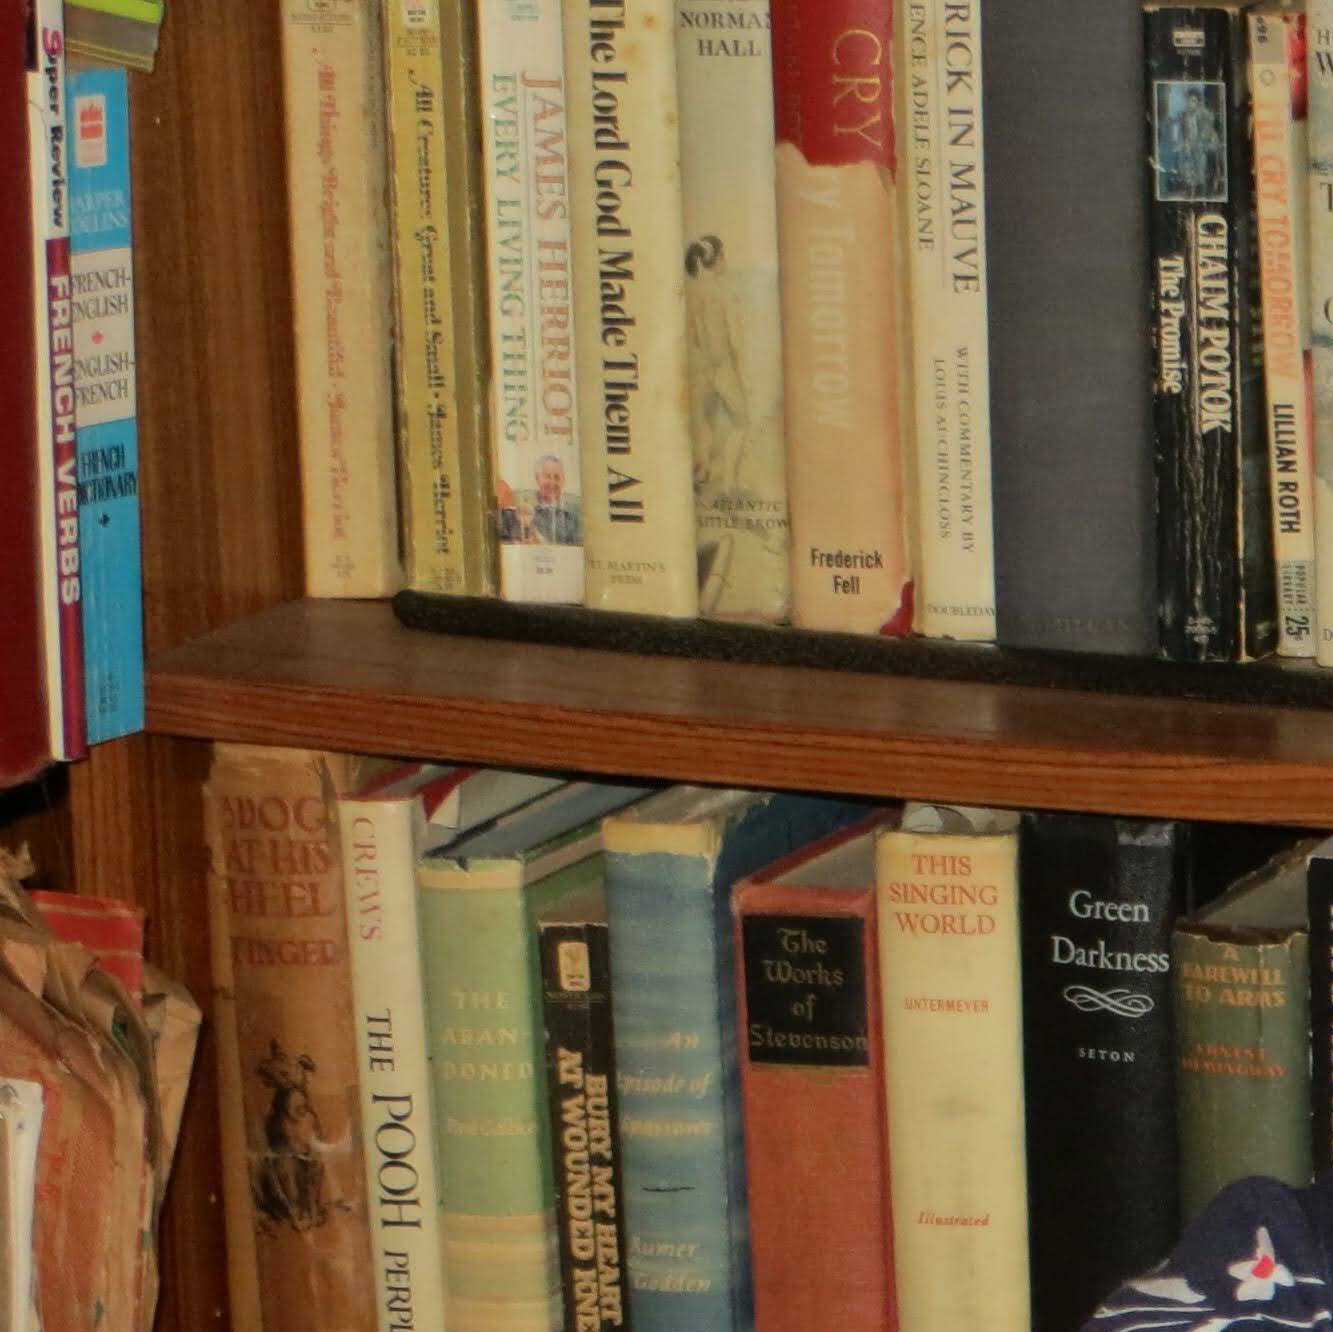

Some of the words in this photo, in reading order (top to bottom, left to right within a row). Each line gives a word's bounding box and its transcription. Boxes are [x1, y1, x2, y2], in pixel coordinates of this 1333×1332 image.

[699, 38, 761, 57] HALL
[493, 73, 520, 183] EVERY
[591, 72, 629, 151] Lord
[833, 28, 882, 152] CRY
[912, 74, 932, 151] ADELE
[948, 108, 974, 148] IN
[50, 125, 66, 228] Review
[521, 70, 566, 220] JAMES
[594, 160, 633, 238] God
[915, 157, 935, 251] SLOANE
[951, 162, 980, 293] MAUVE
[497, 201, 528, 316] LIVING
[1158, 254, 1185, 298] The
[1199, 214, 1229, 315] CHAIM
[598, 249, 637, 347] Made
[51, 276, 76, 444] FRENCH
[538, 240, 574, 445] HERRIOT
[1160, 300, 1184, 394] Promise
[1200, 318, 1232, 432] POTOK
[502, 335, 529, 443] THING
[603, 354, 639, 456] Them
[957, 400, 974, 527] COMMENTARY
[1272, 404, 1297, 473] LILLIAN
[57, 458, 80, 604] VERBS
[607, 468, 644, 524] All
[1278, 481, 1300, 534] ROTH
[811, 548, 883, 570] Frederick
[833, 575, 860, 595] Fell
[352, 817, 382, 940] CREWS
[890, 883, 998, 906] SINGING
[912, 854, 972, 876] THIS
[777, 928, 829, 954] The
[895, 912, 996, 936] WORLD
[1069, 890, 1150, 922] Green
[761, 960, 845, 986] Works
[1051, 936, 1170, 973] Darkness
[367, 1008, 395, 1072] THE
[750, 1024, 868, 1050] Stevenson
[792, 994, 816, 1022] of
[1079, 1048, 1135, 1062] SETON
[584, 1074, 610, 1159] BURY
[372, 1094, 422, 1228] POOH
[561, 1100, 592, 1258] WOUNDED
[592, 1167, 616, 1218] MY
[919, 1211, 991, 1228] Illustrated
[599, 1224, 622, 1325] HEART
